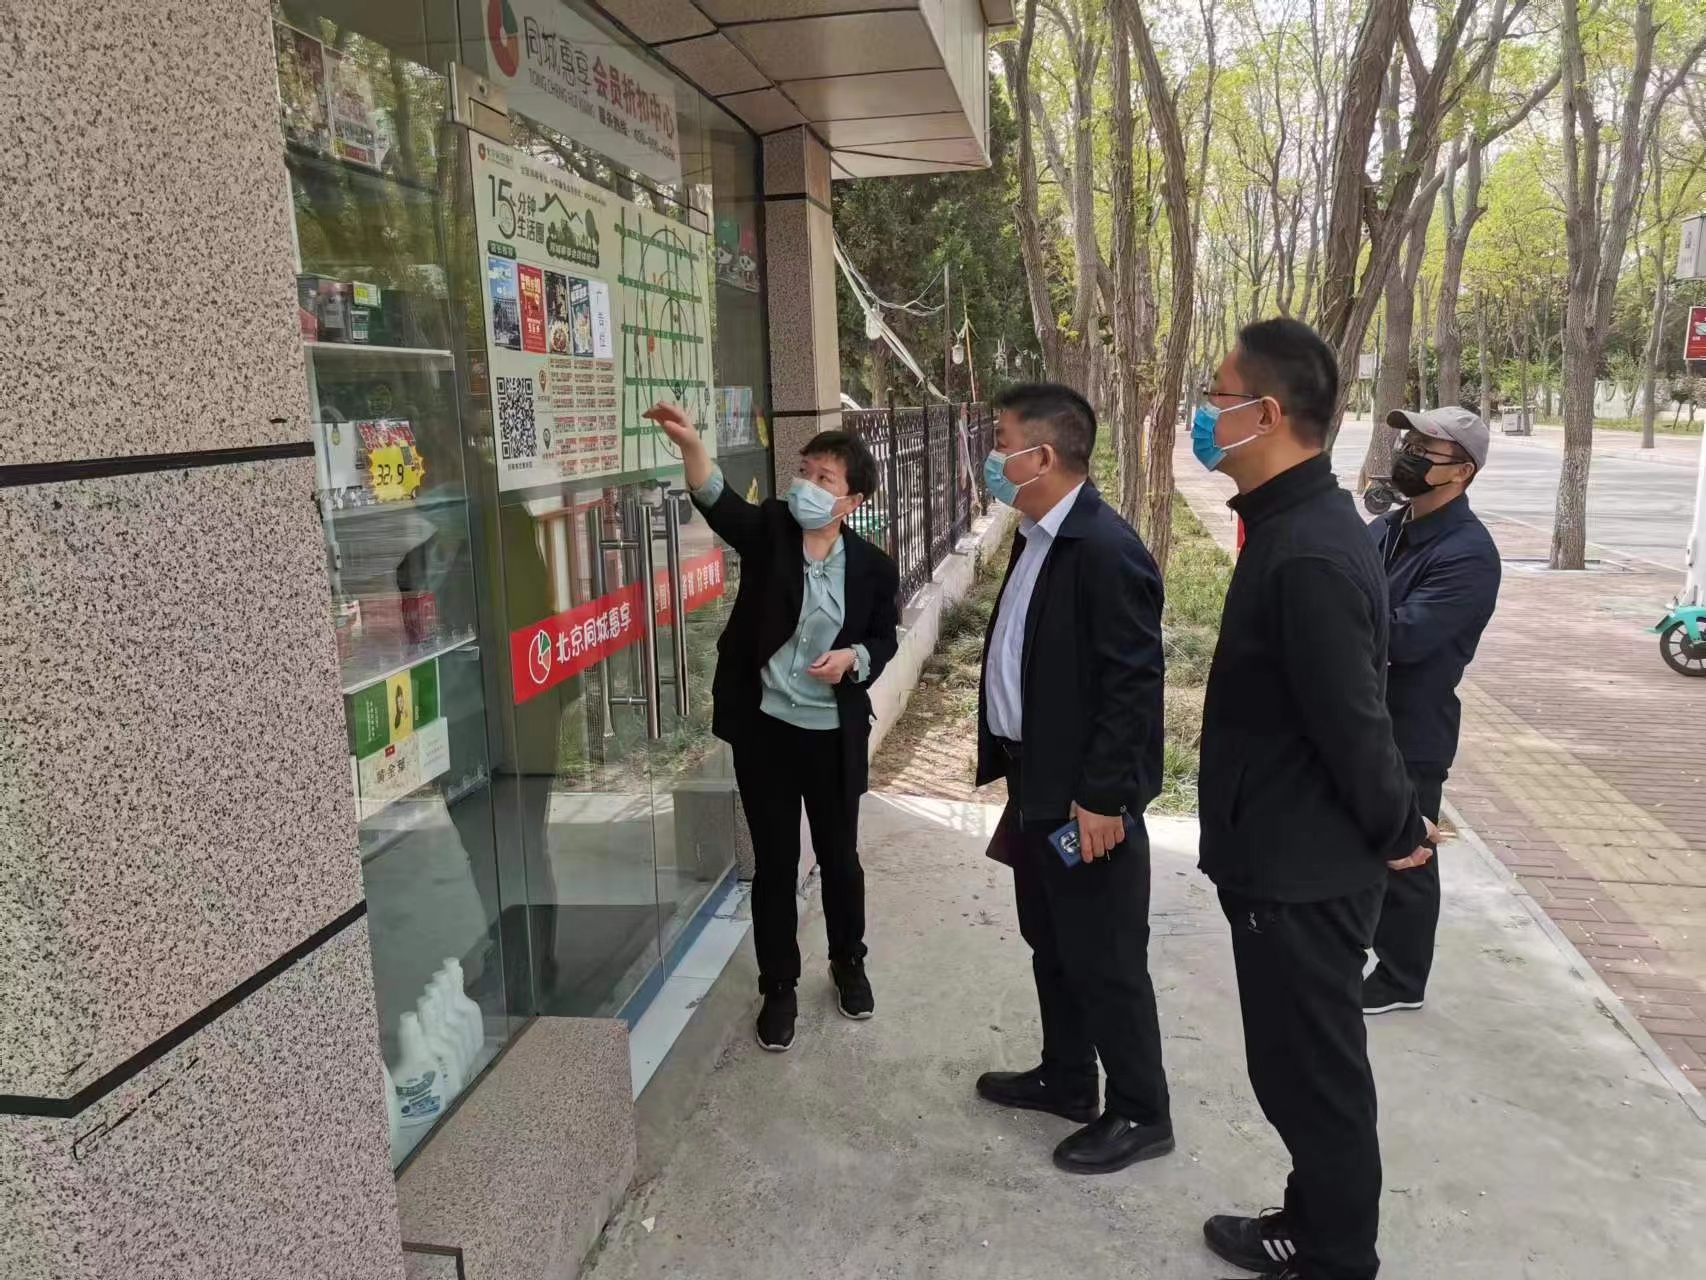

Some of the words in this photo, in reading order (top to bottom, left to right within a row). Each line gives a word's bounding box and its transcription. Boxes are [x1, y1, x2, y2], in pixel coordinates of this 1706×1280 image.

[517, 191, 537, 217] 分钟
[516, 215, 545, 244] 生活圈
[555, 600, 632, 664] 北京同城惠享
